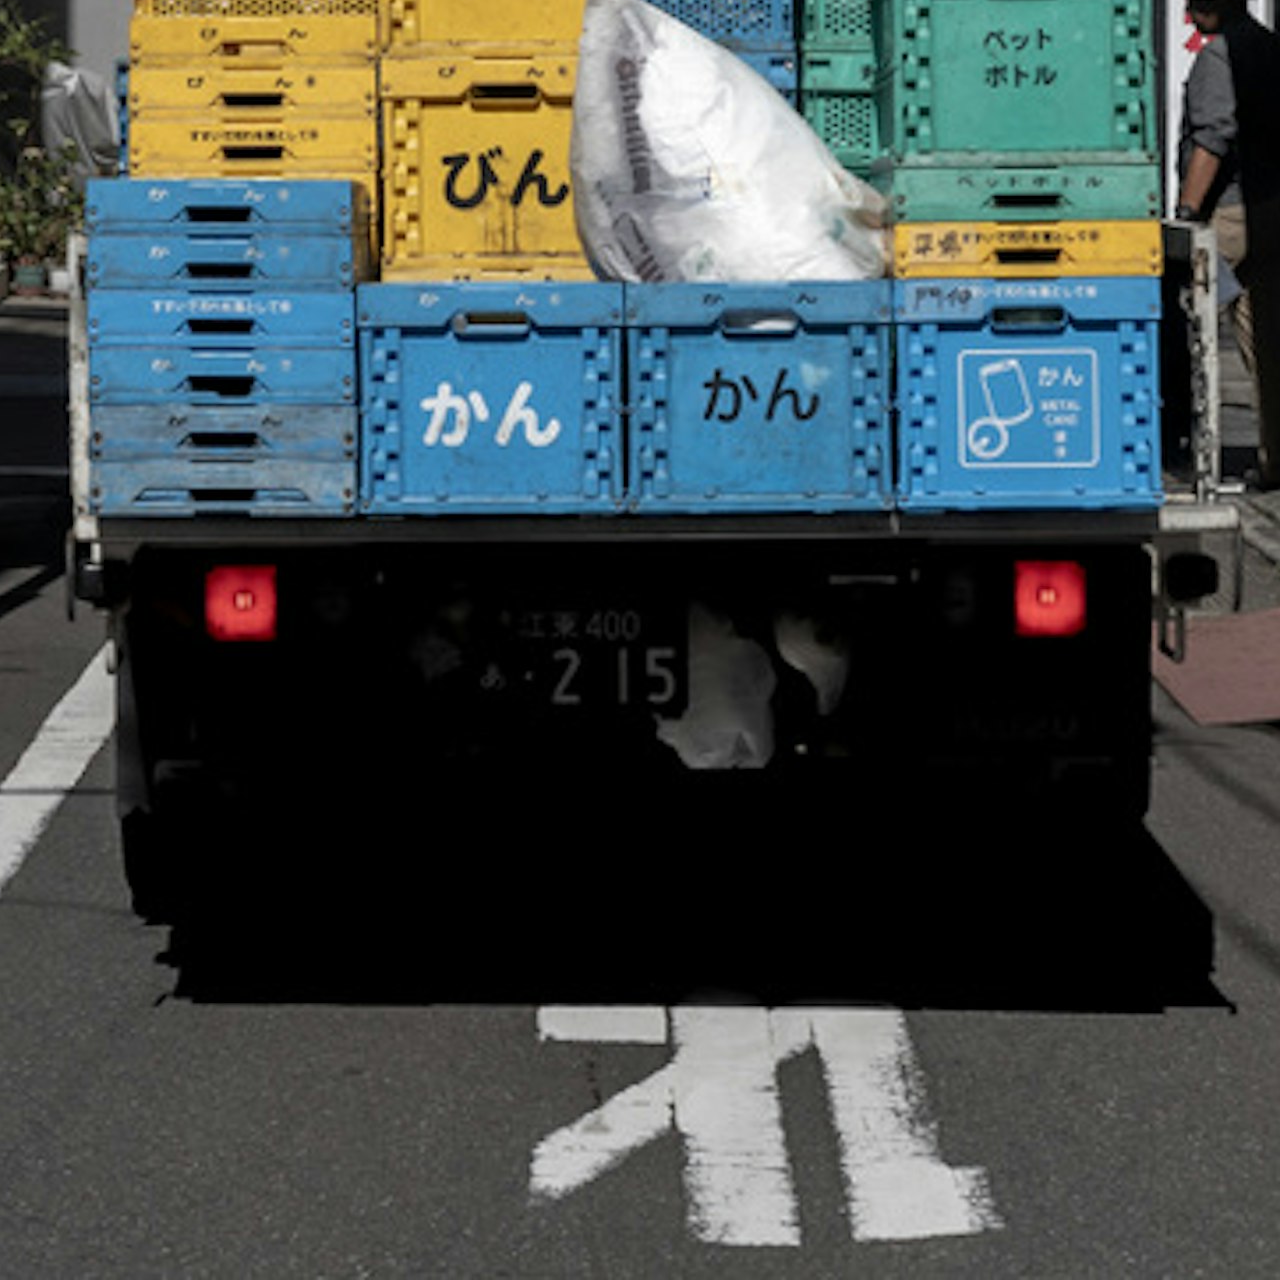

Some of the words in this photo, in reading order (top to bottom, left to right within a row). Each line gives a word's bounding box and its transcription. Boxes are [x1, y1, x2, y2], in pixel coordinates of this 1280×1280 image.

[982, 28, 1053, 51] ペット
[984, 65, 1058, 88] ボトル
[441, 145, 570, 210] びん
[1038, 365, 1084, 387] かん
[702, 368, 819, 424] かん
[420, 381, 562, 448] かん
[517, 610, 580, 639] 江東
[585, 609, 642, 642] 400
